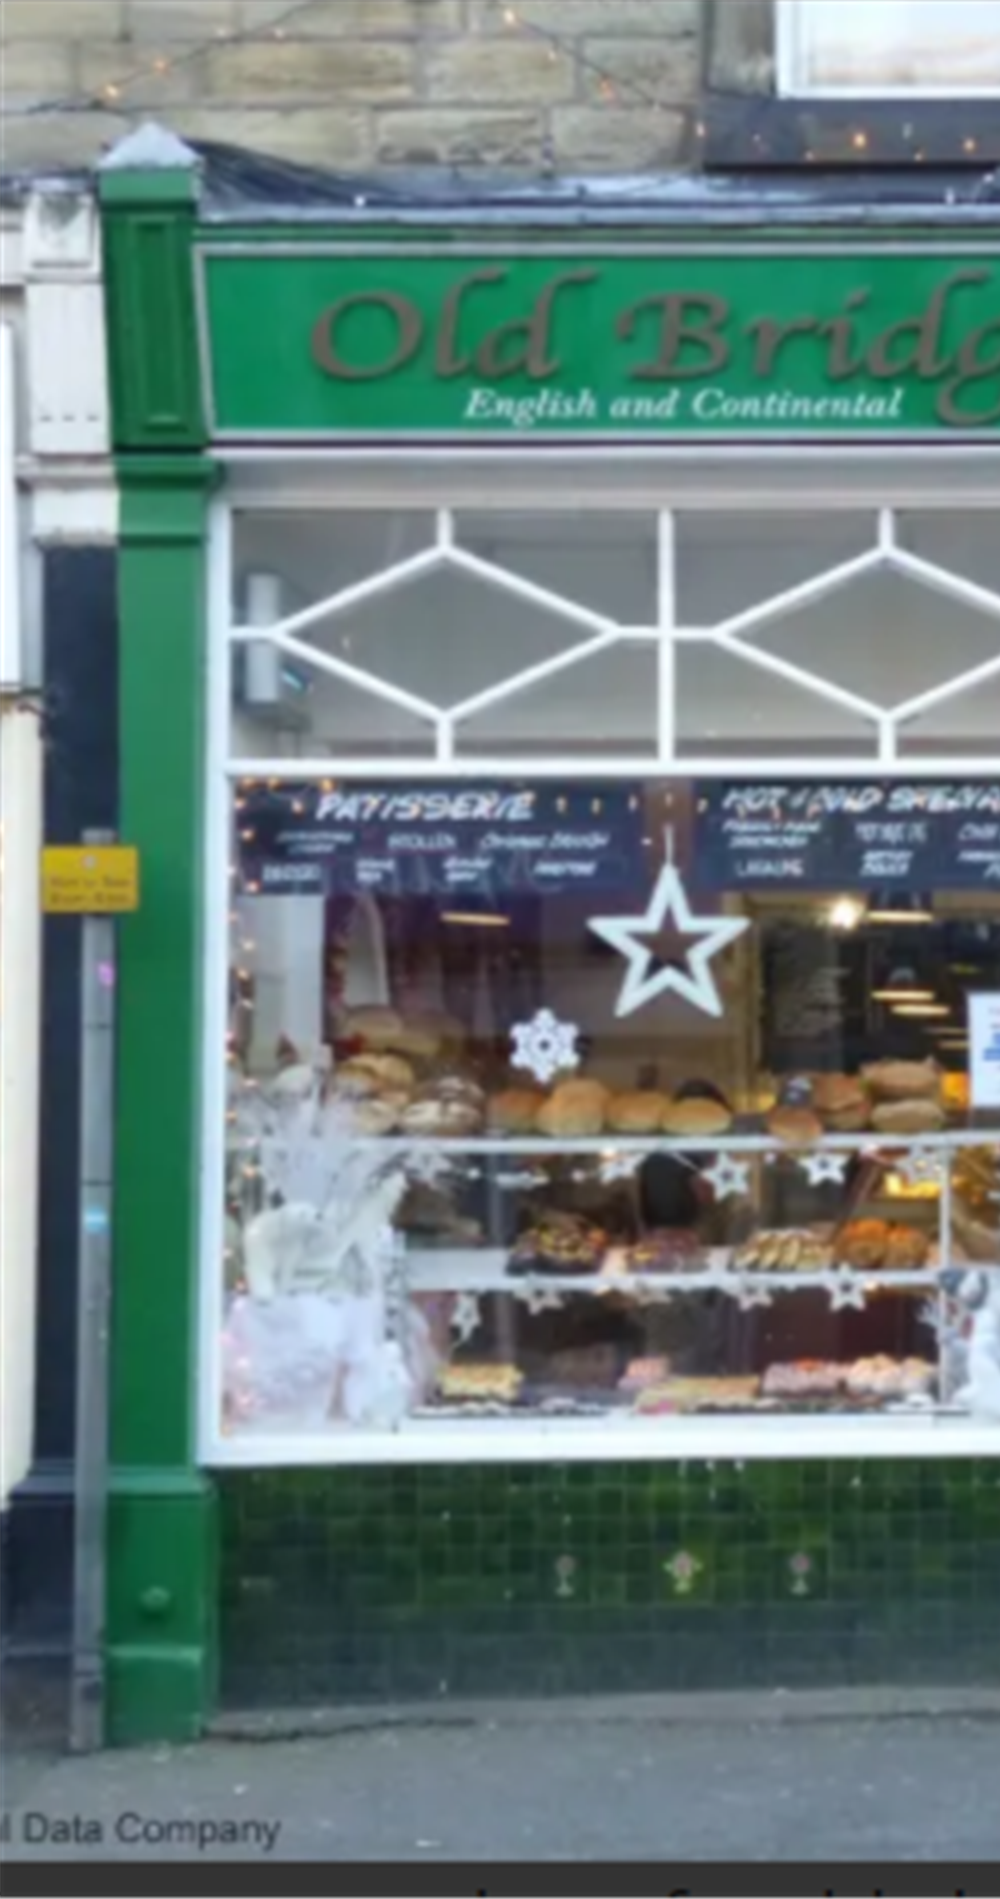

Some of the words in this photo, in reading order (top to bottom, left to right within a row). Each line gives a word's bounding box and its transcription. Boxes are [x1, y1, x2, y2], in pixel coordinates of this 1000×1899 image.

[308, 264, 600, 381] Old
[463, 387, 597, 428] English
[607, 387, 678, 420] and
[690, 387, 904, 420] Continental
[315, 791, 536, 822] PATISSERIE
